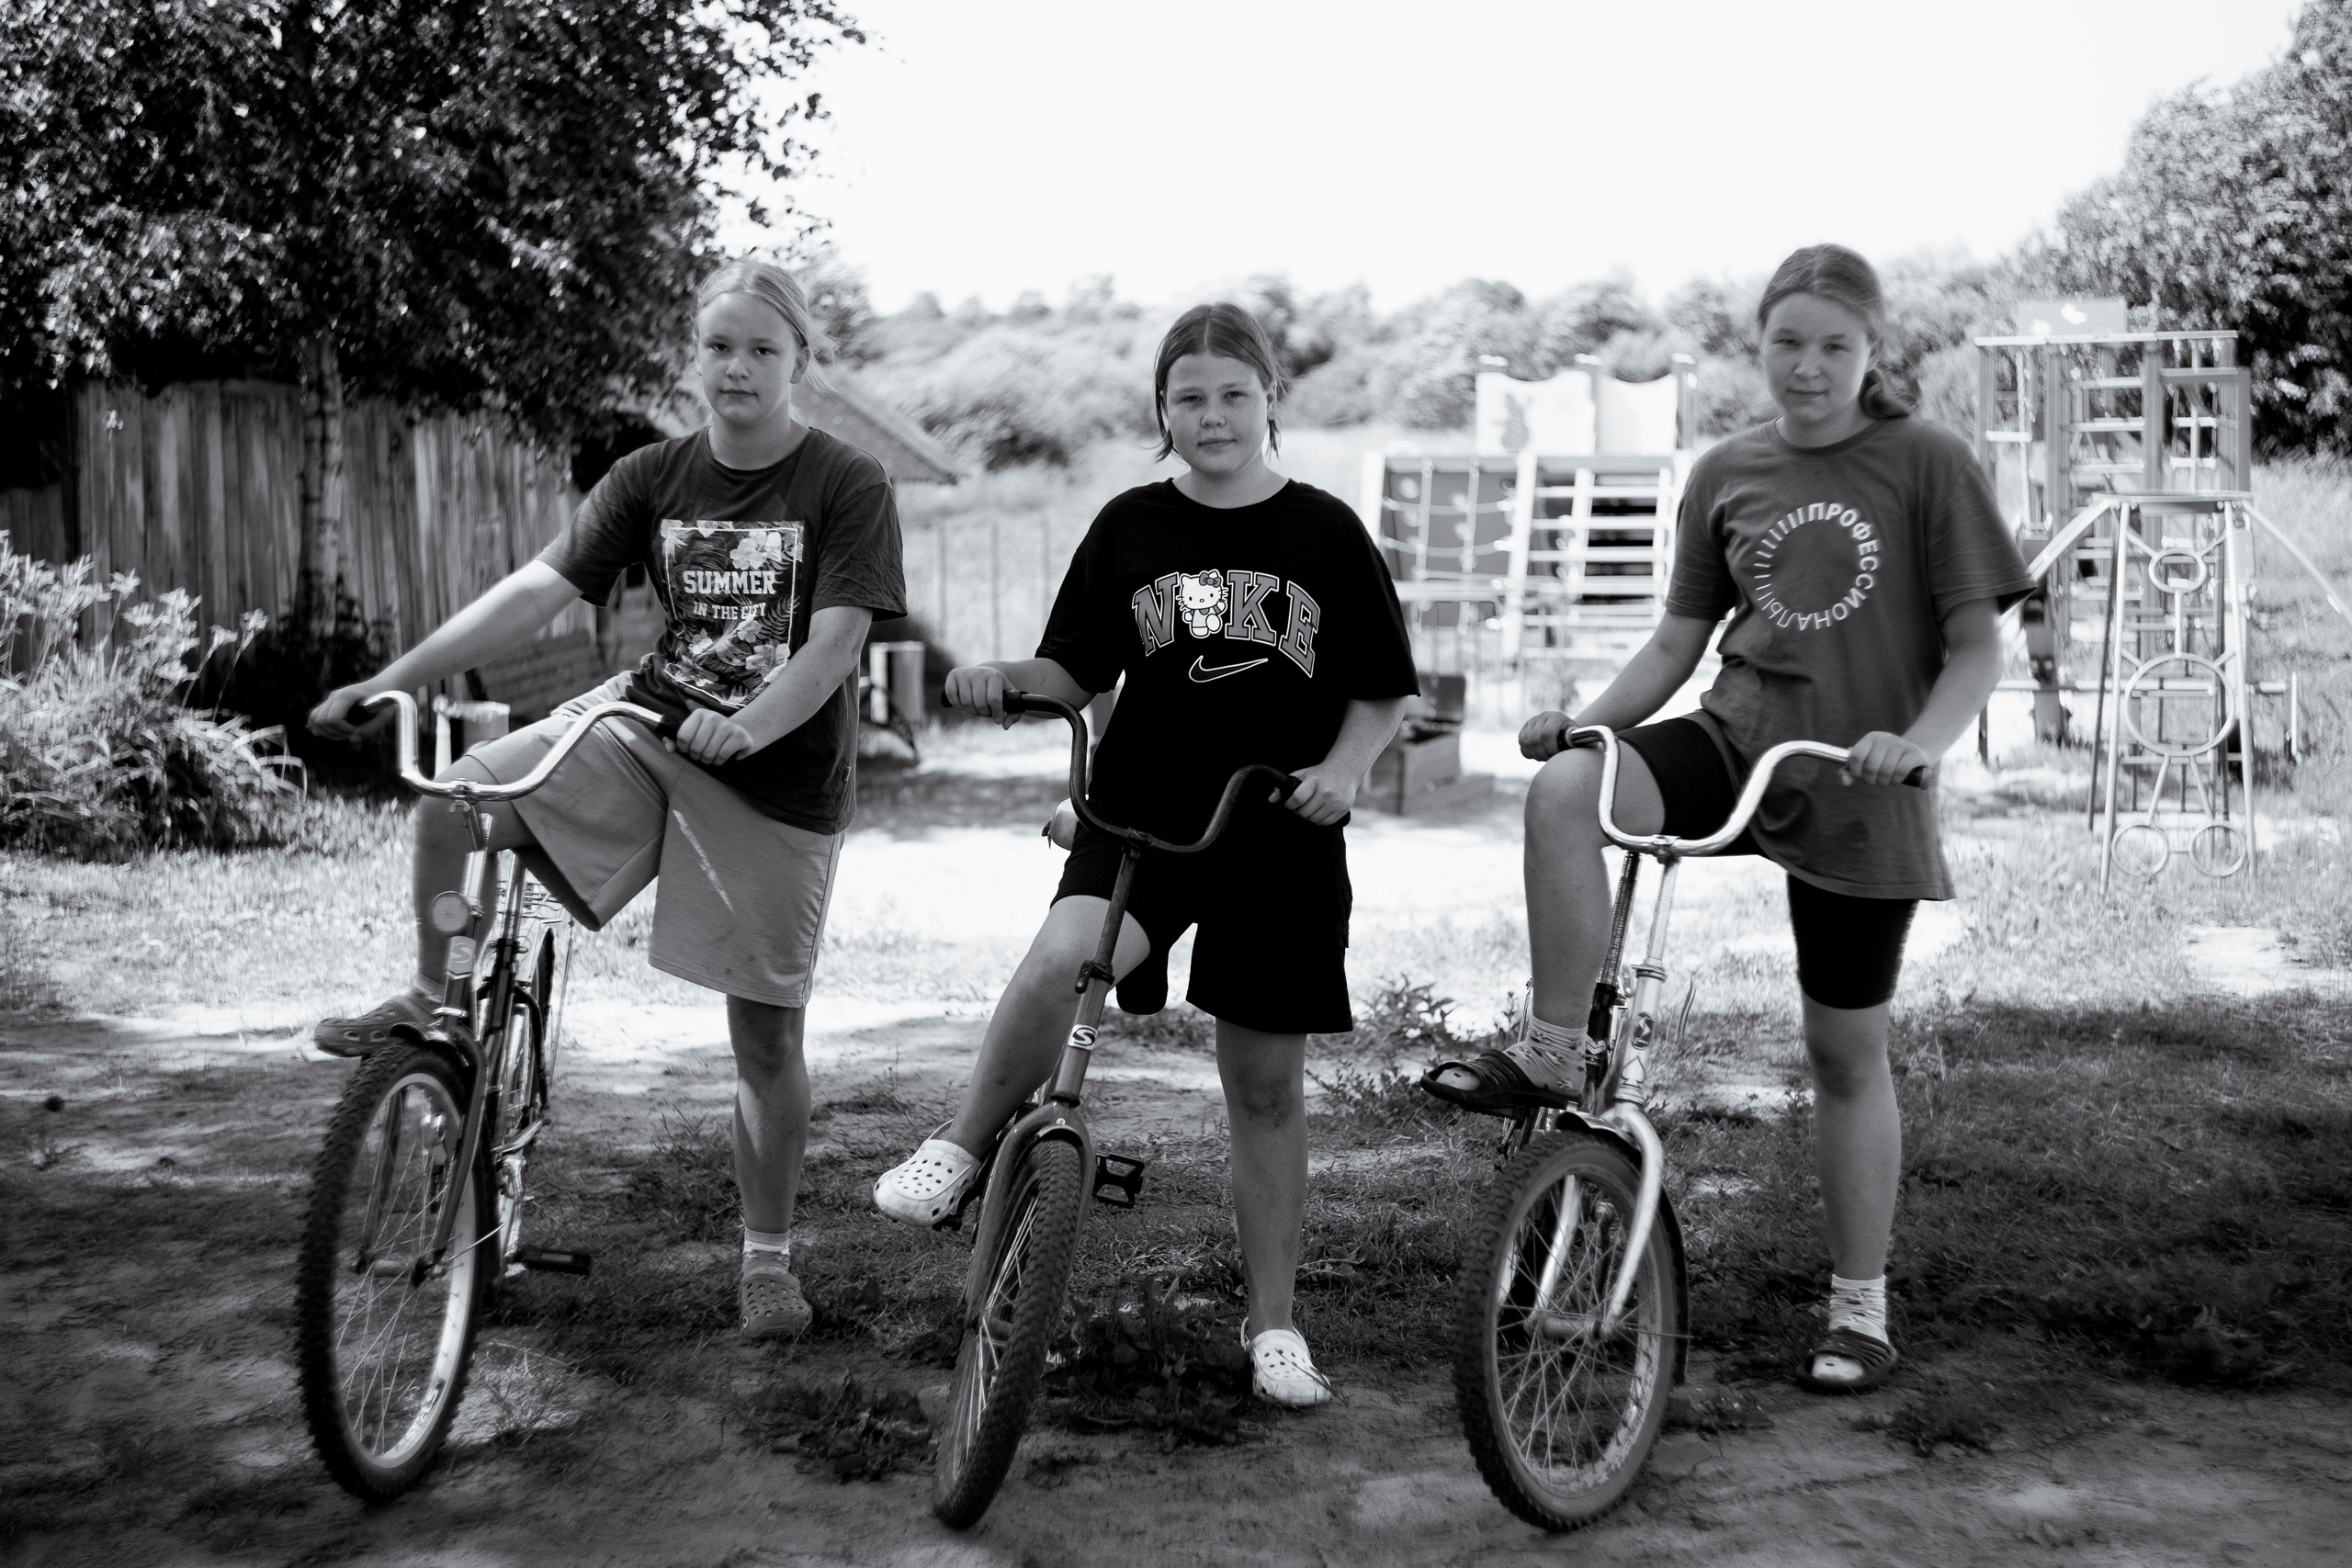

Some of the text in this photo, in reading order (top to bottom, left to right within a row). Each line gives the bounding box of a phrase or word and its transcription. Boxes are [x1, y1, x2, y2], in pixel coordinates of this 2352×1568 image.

[683, 570, 778, 595] SUMMER
[693, 601, 767, 620] IN THE CITY
[1131, 570, 1321, 679] NKE
